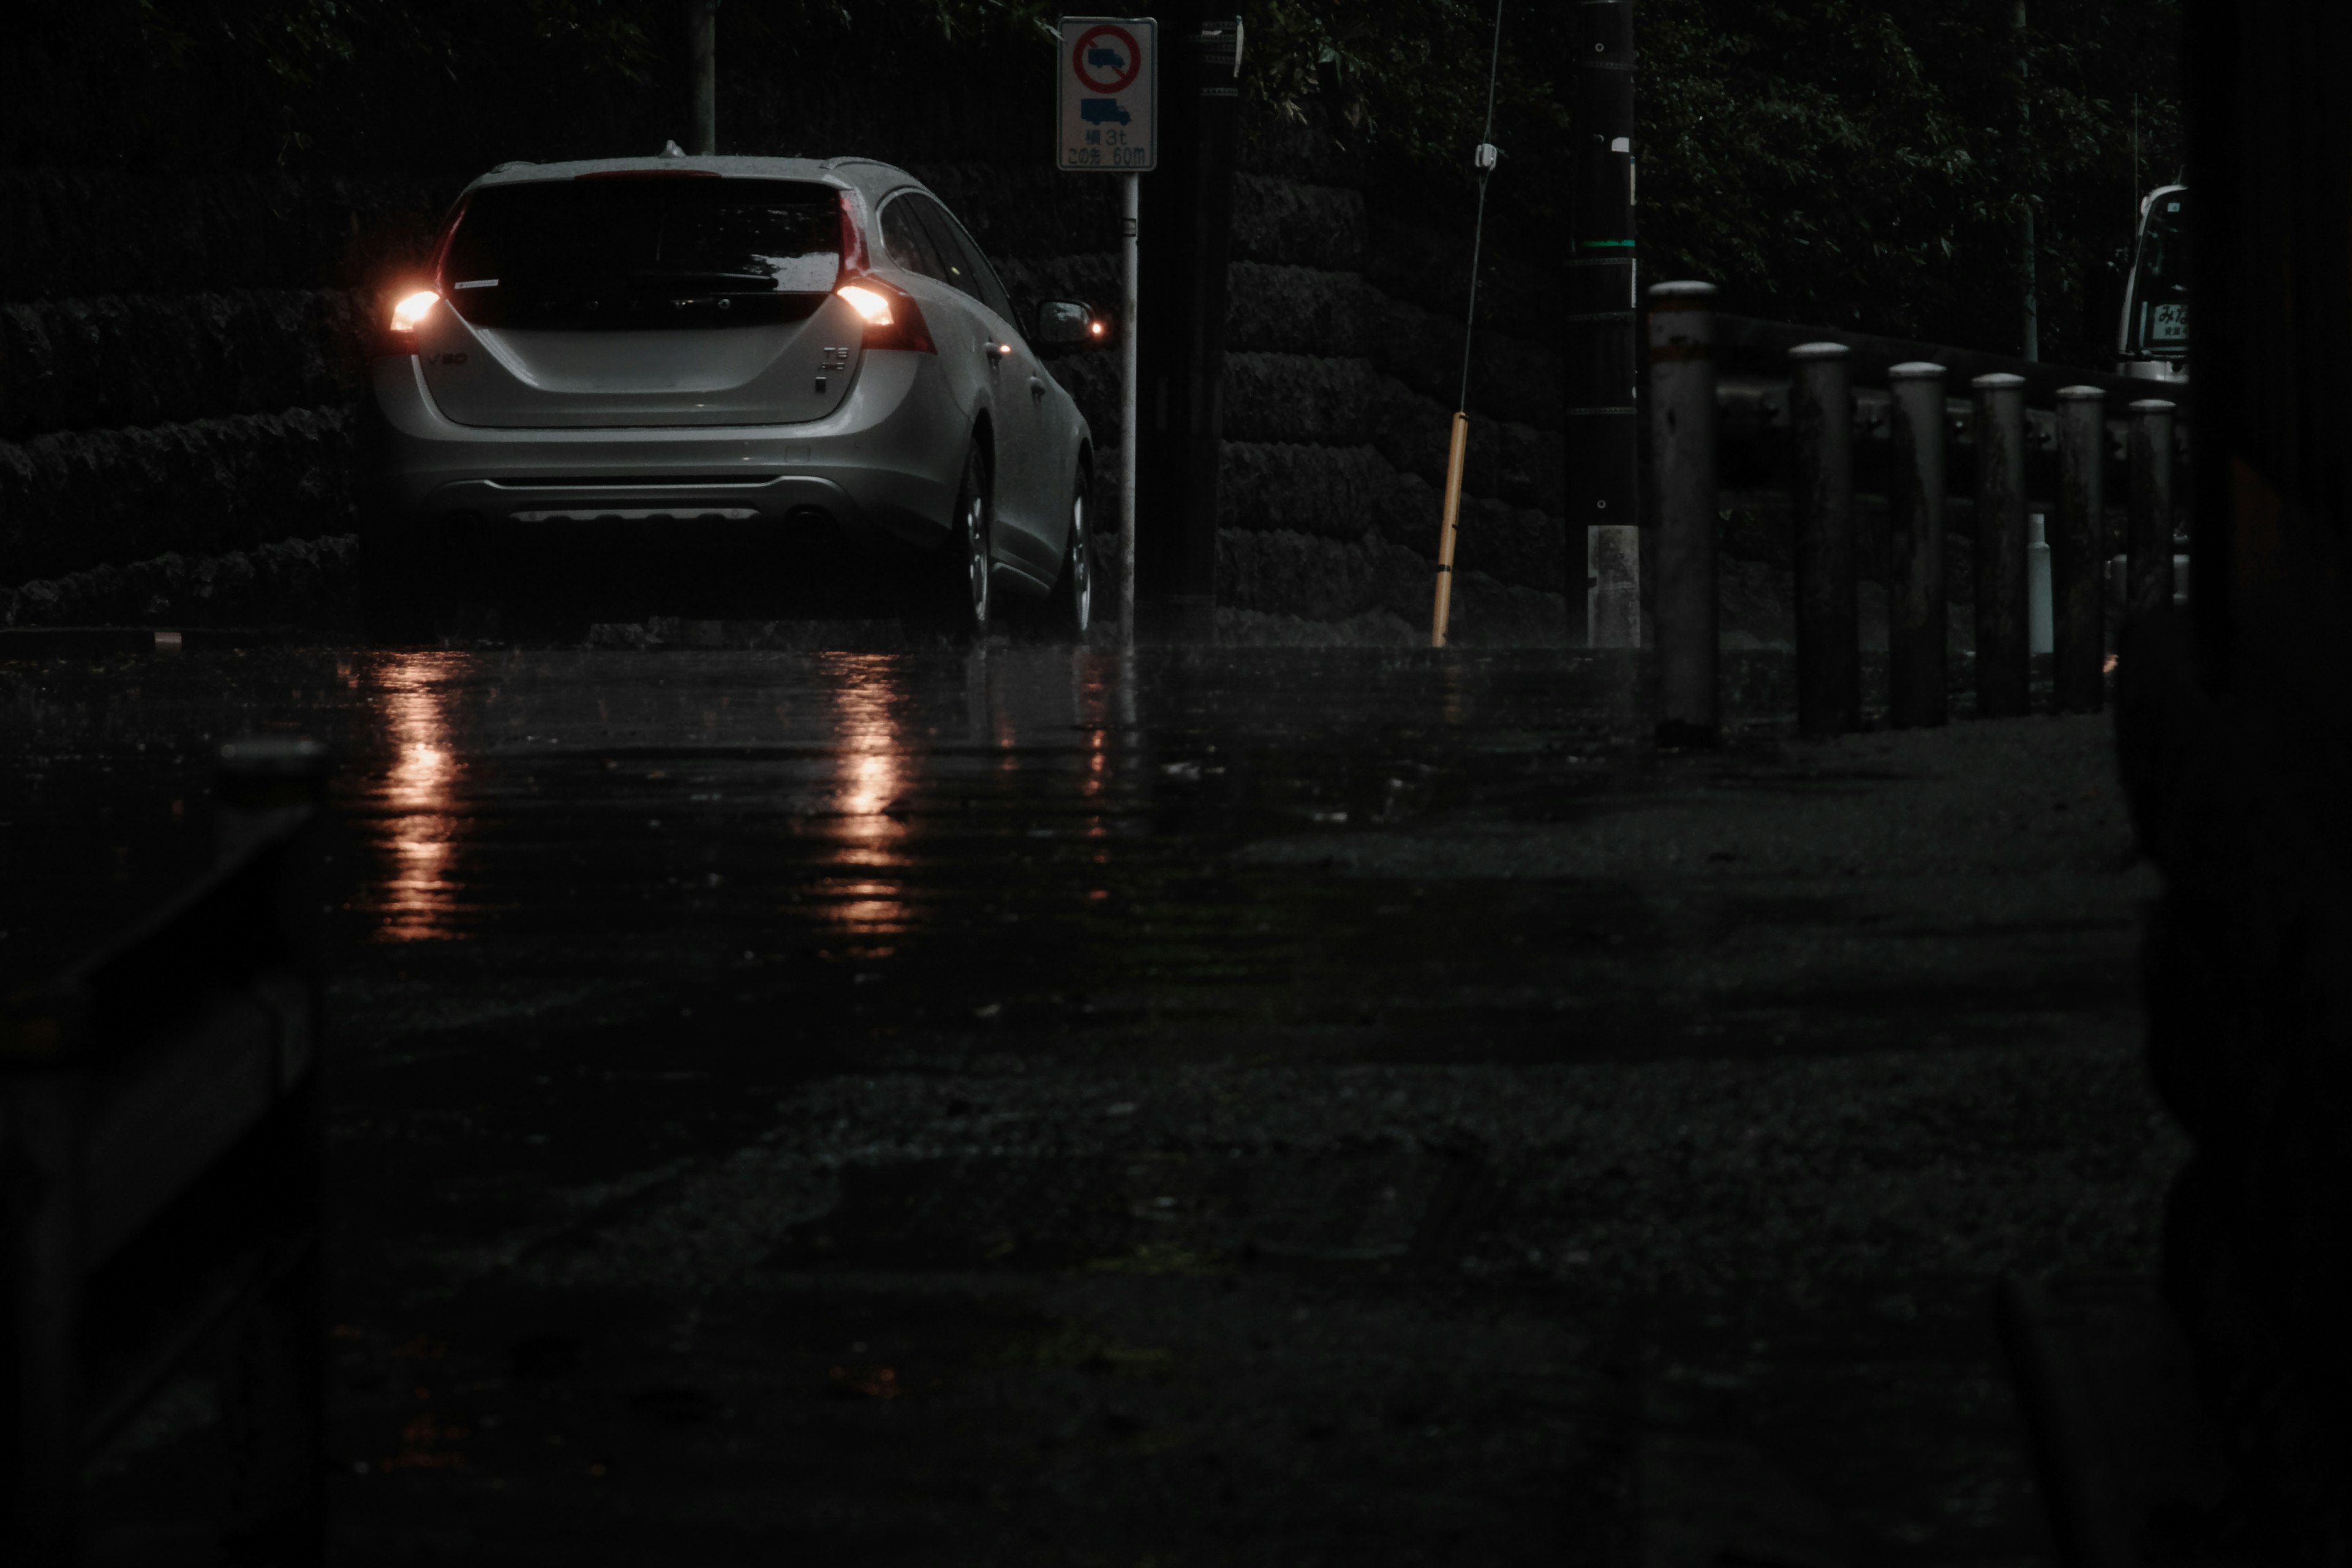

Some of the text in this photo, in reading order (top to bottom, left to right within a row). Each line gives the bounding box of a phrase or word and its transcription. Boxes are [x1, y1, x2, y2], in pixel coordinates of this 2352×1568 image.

[1068, 147, 1145, 166] この先 60m
